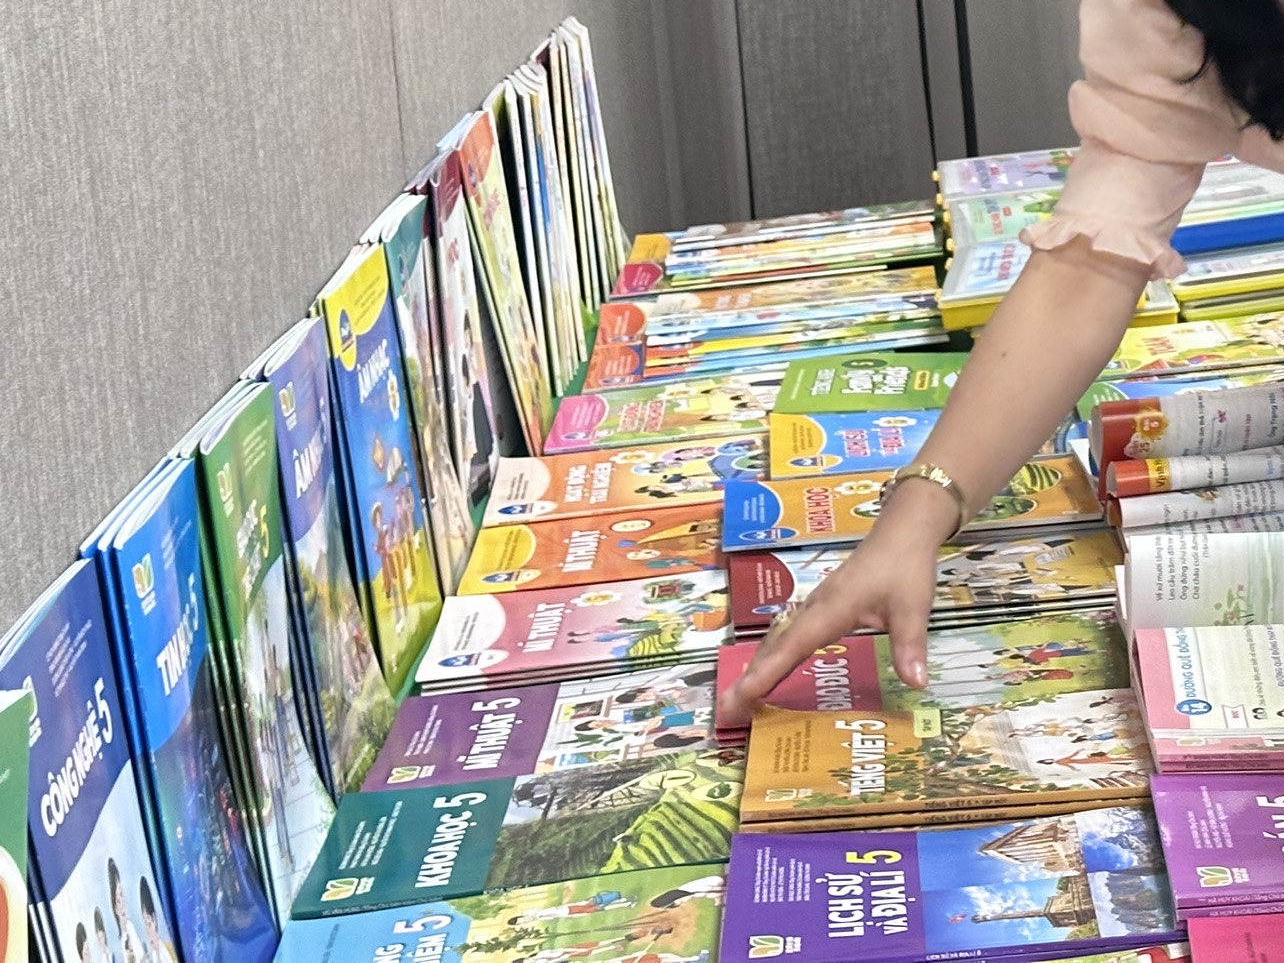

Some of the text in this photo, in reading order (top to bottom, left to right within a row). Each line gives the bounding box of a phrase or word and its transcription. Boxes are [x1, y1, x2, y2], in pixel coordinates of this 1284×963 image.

[803, 487, 839, 507] HỌC
[806, 508, 835, 533] KHOA
[528, 603, 573, 639] THUẬT
[811, 644, 860, 710] ĐẠO ĐỨC 5
[1172, 634, 1197, 697] ĐƯỜNG QUÊ ĐỒNG
[471, 697, 521, 712] 5
[468, 713, 522, 755] THUẬT
[41, 677, 113, 837] CÔNG NGHỆ 5
[835, 719, 895, 796] TIẾNG VIỆT 5
[414, 792, 487, 888] KHOA HỌC 5
[845, 849, 902, 865] 5
[815, 872, 874, 938] LỊCH SỬ
[859, 870, 916, 935] VÀ ĐỊA LÍ
[392, 915, 452, 934] 5
[406, 933, 451, 963] IỆM
